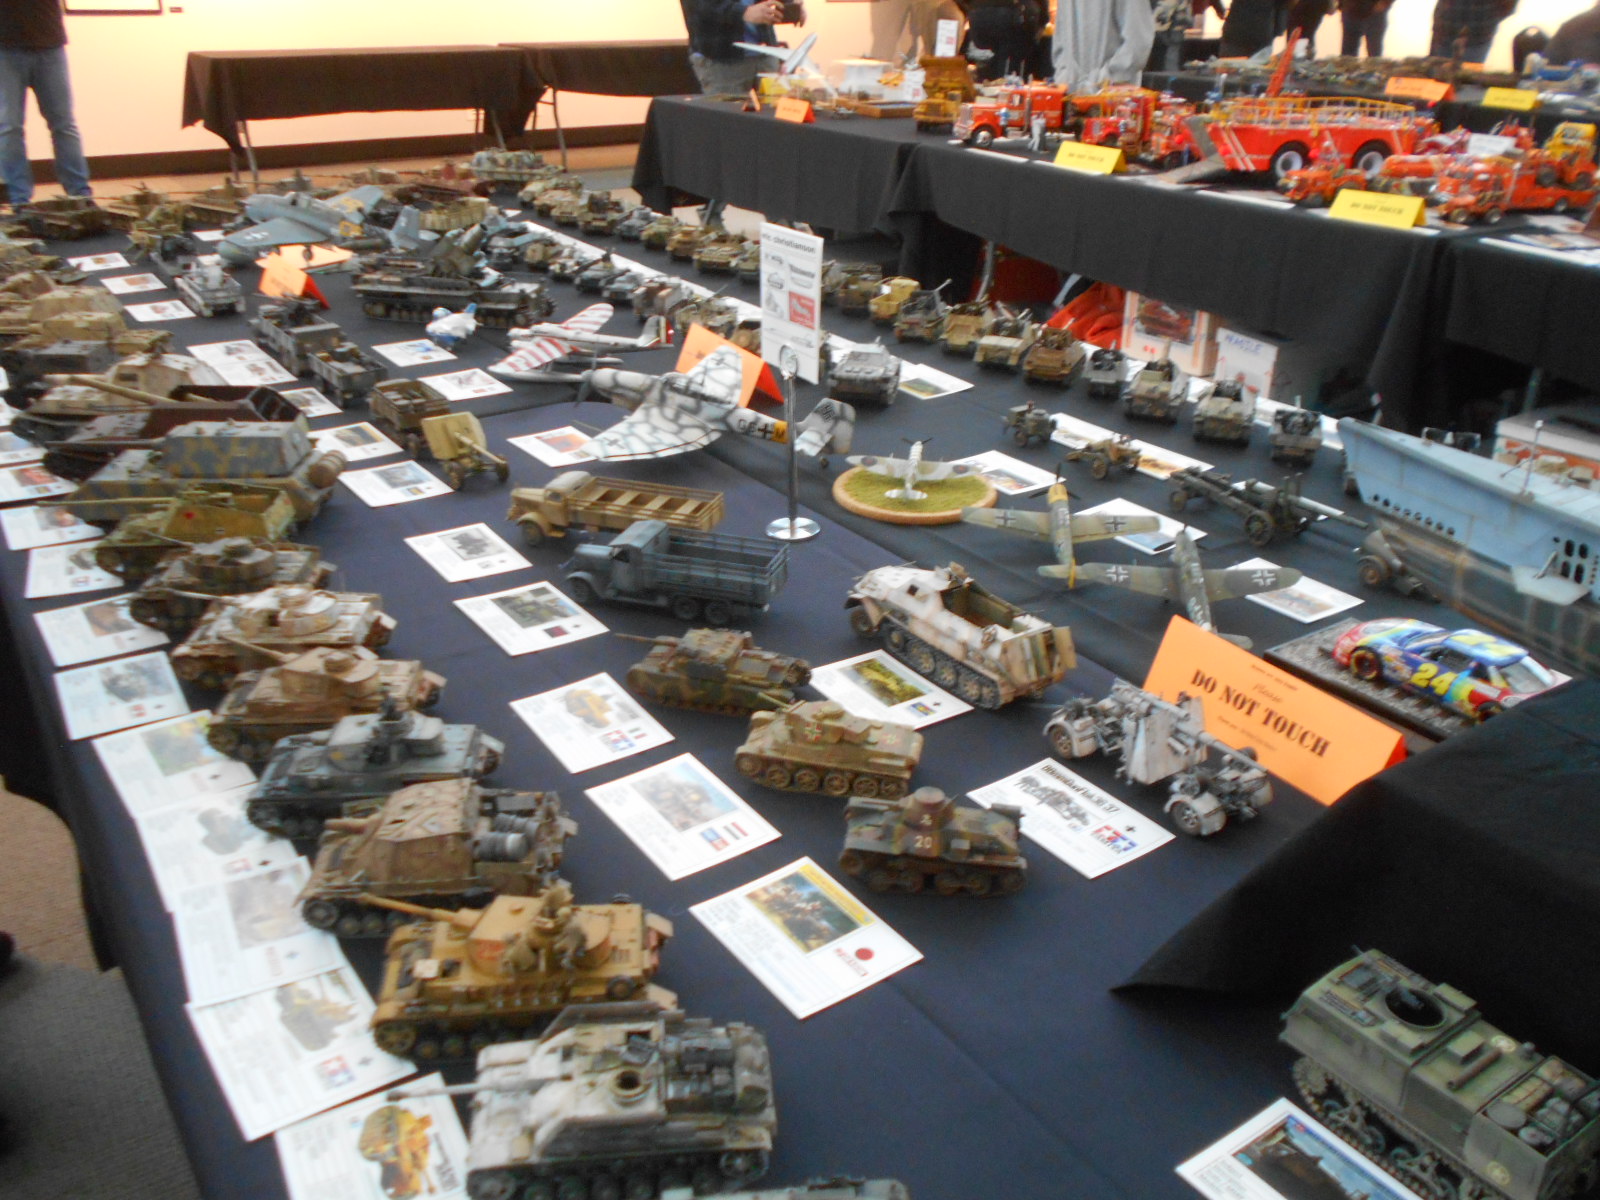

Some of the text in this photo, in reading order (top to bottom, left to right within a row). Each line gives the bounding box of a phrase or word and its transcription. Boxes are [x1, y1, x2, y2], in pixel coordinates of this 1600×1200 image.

[1411, 662, 1458, 696] 24
[1191, 669, 1217, 694] DO
[1219, 685, 1261, 716] NOT
[1262, 707, 1331, 757] TOUCH
[914, 835, 933, 849] 20
